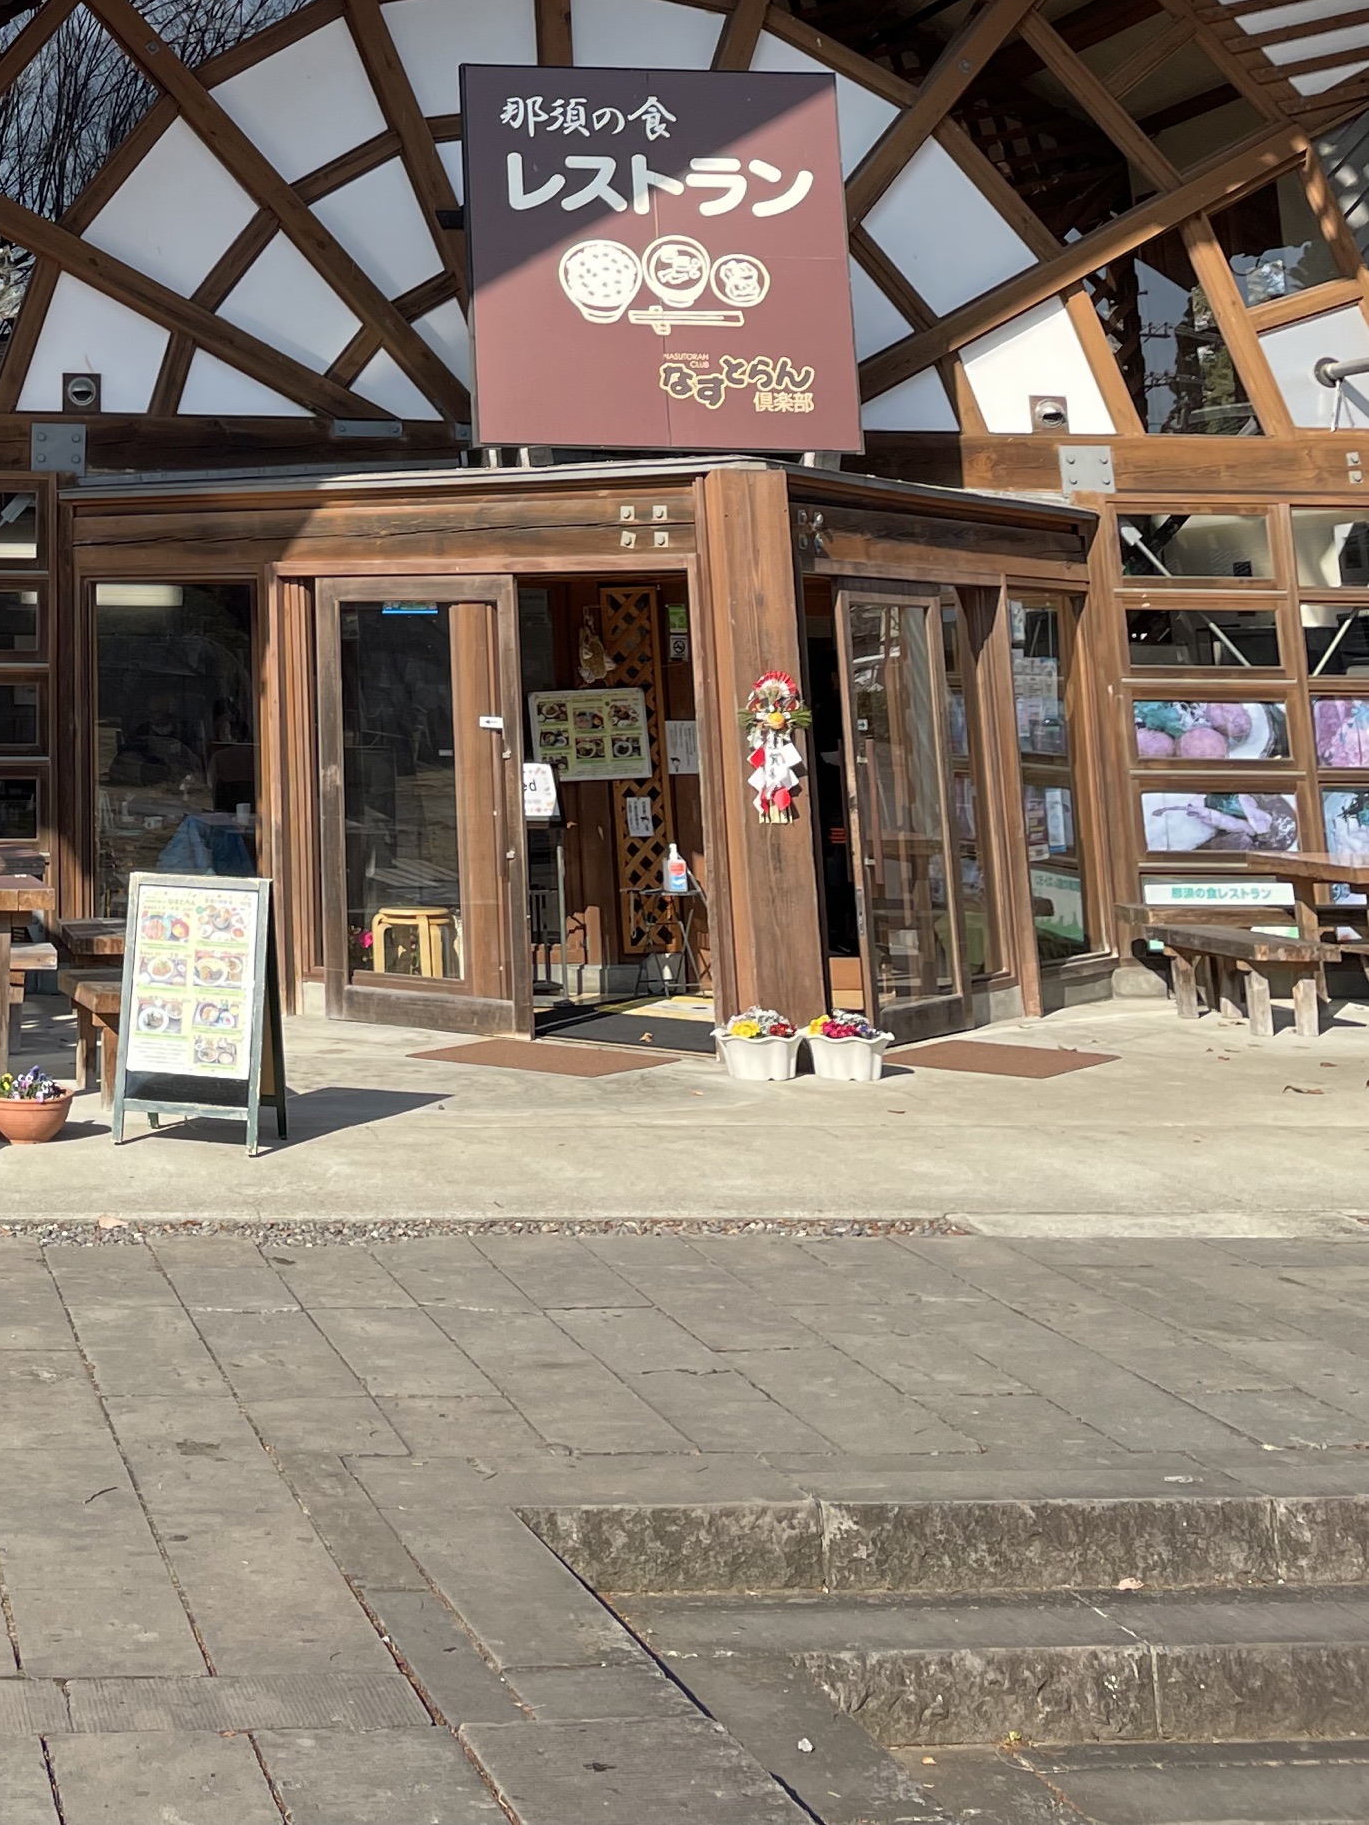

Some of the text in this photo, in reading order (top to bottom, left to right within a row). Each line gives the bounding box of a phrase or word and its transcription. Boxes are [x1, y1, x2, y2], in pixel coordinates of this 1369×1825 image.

[499, 95, 677, 141] 那須の食
[506, 152, 814, 218] レストラン
[689, 360, 710, 369] CLUB
[659, 354, 815, 410] なすとらん
[753, 391, 815, 413] 倶楽部
[1171, 887, 1272, 900] 那須の食レストラン
